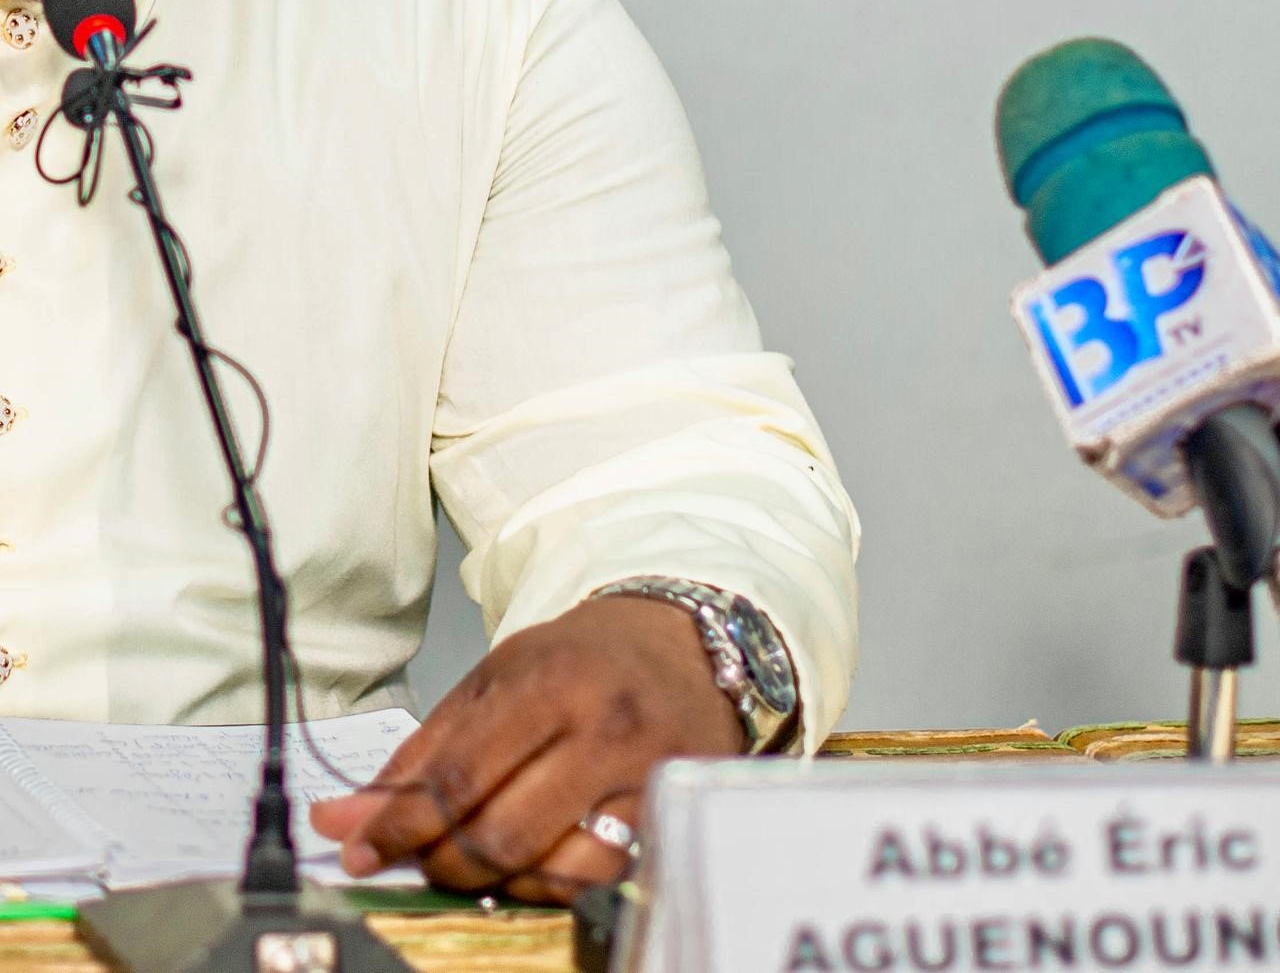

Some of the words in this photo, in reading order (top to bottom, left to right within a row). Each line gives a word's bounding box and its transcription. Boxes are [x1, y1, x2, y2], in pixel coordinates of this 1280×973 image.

[868, 822, 1070, 880] Abbé
[1104, 804, 1258, 876] Éric
[784, 904, 1280, 973] AGUENOUN
